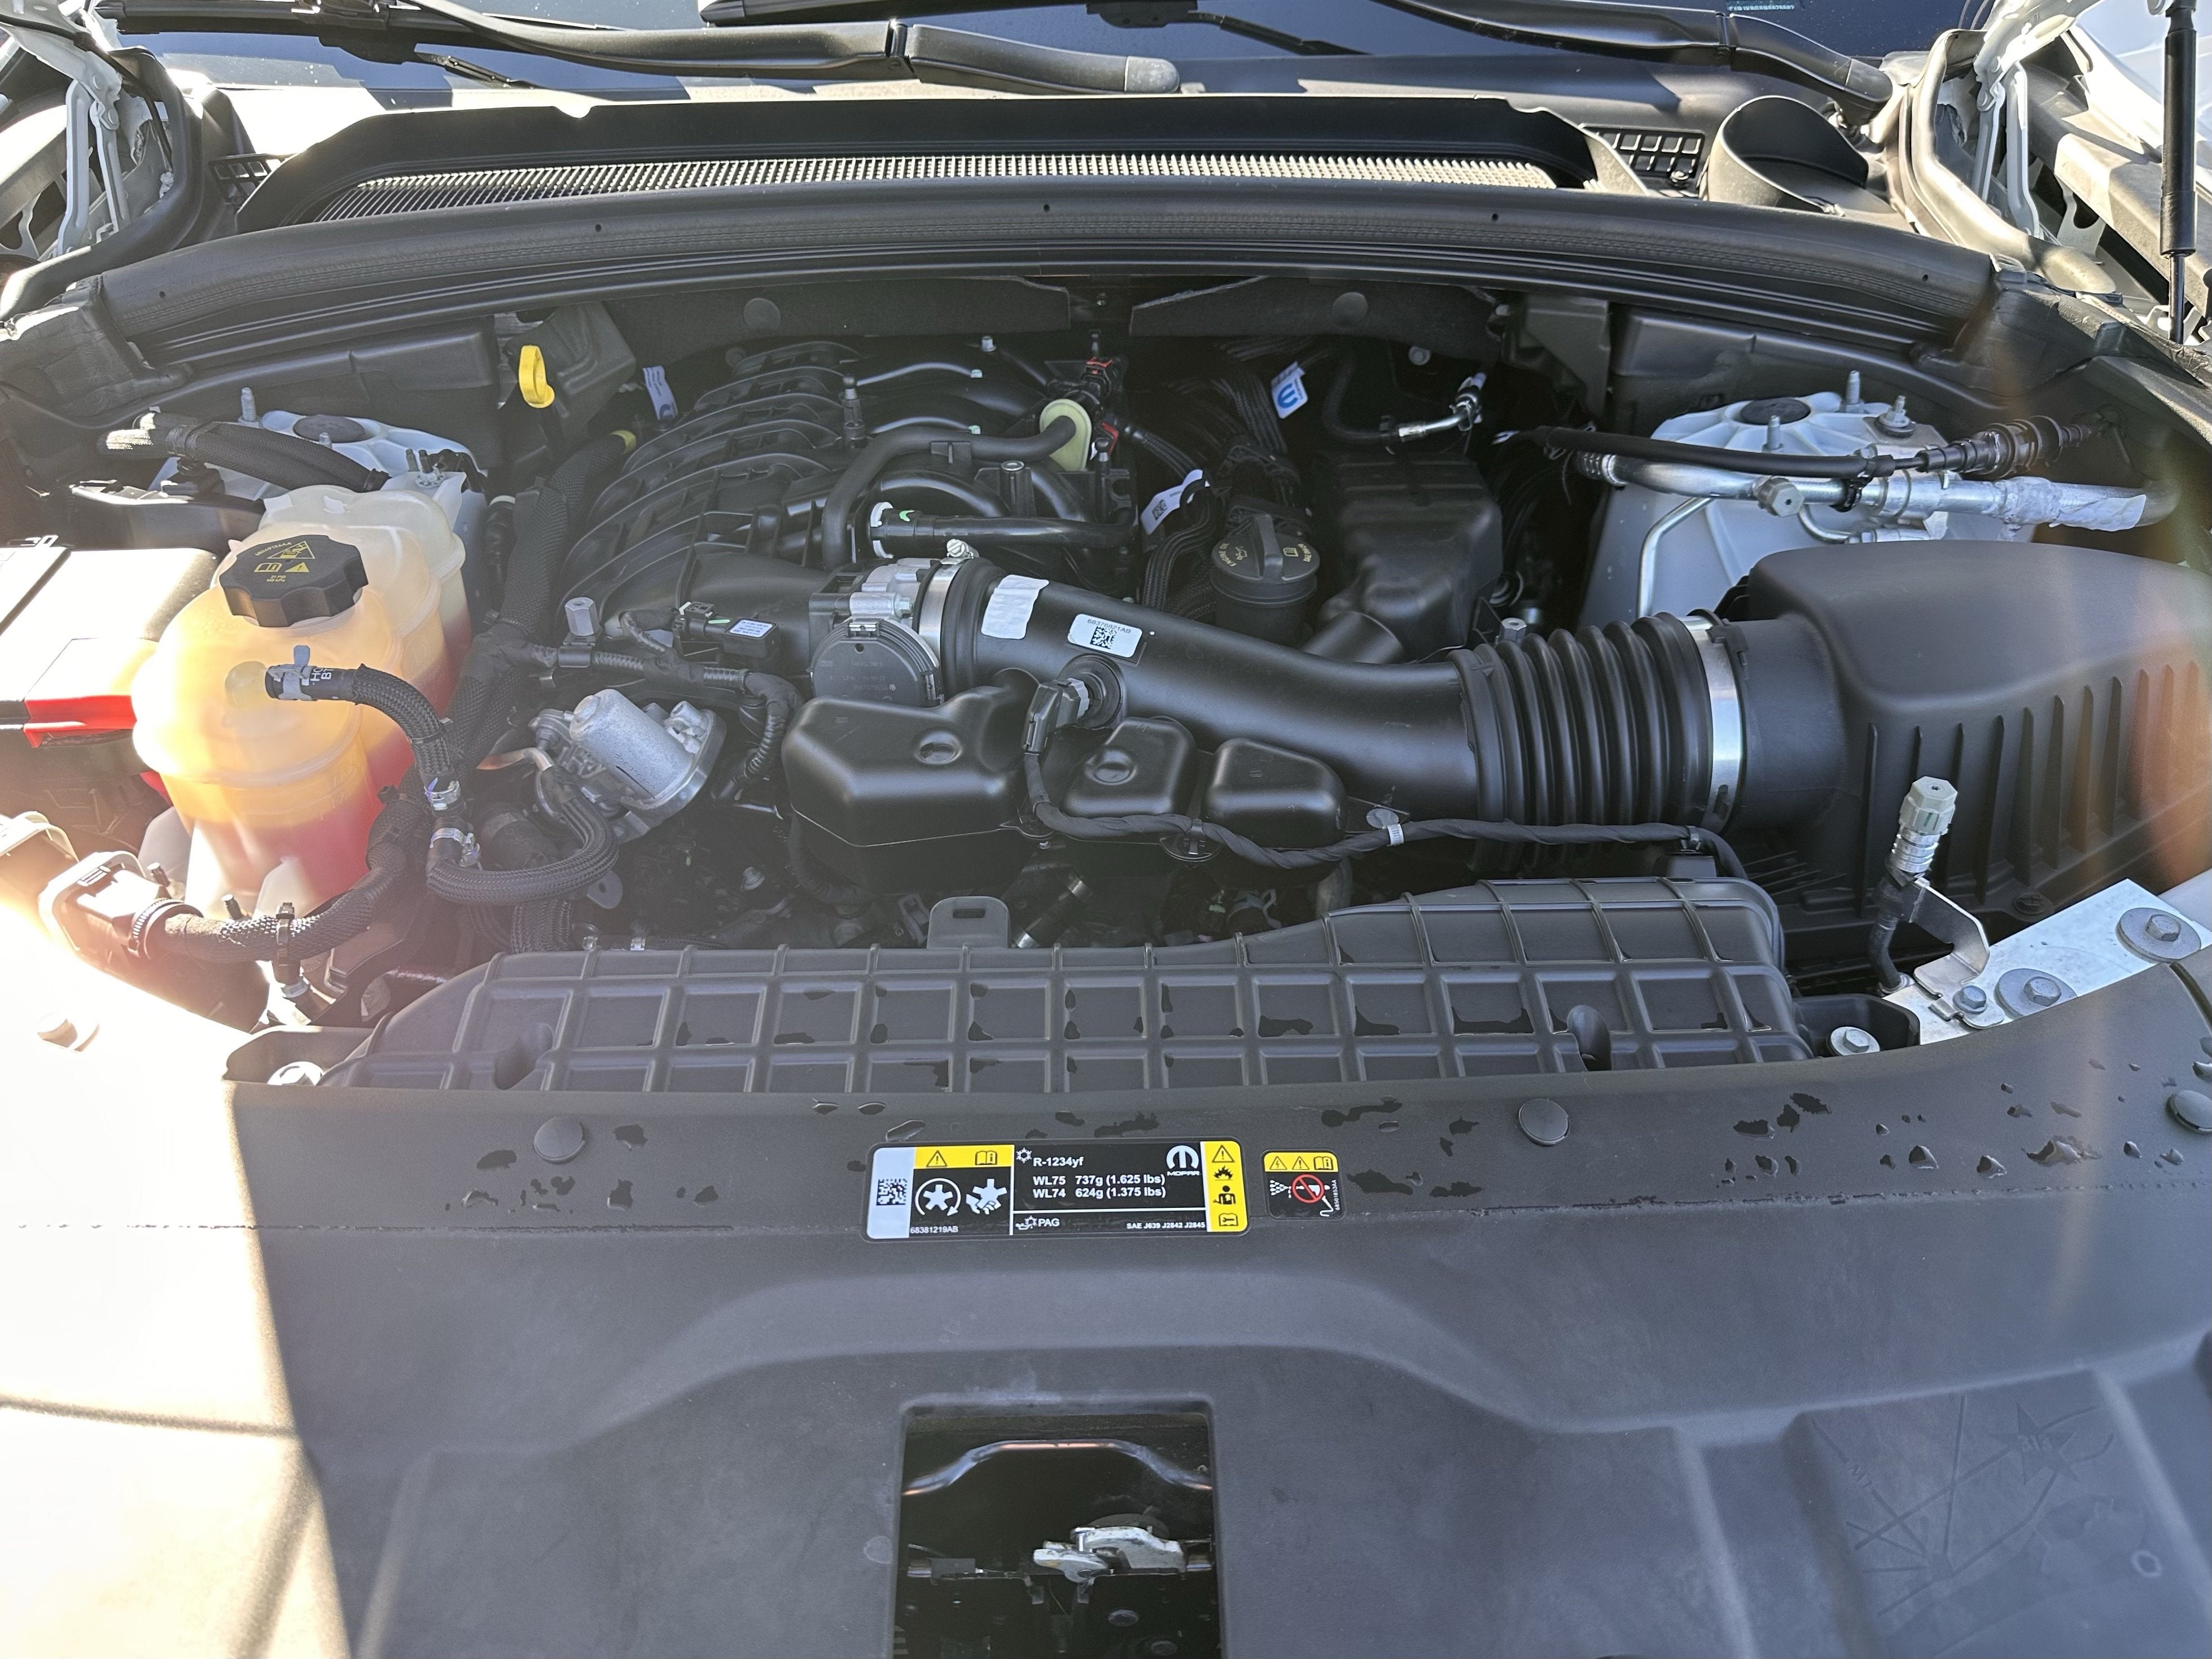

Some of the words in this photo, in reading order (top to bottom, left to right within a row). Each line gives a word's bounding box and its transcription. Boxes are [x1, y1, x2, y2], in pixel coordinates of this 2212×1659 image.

[1219, 550, 1237, 567] ENGINE
[1032, 1157, 1084, 1168] R-1234yf
[1032, 1175, 1066, 1185] WL75
[1075, 1175, 1103, 1187] 737g
[1106, 1175, 1141, 1187] (1.625
[1143, 1174, 1166, 1186] lbs)
[1032, 1188, 1066, 1198] WL74
[1075, 1187, 1103, 1199] 624g
[1106, 1187, 1142, 1199] (1.375
[1144, 1186, 1167, 1198] lbs)
[1037, 1218, 1060, 1227] PAG
[910, 1225, 958, 1234] 68381219AB
